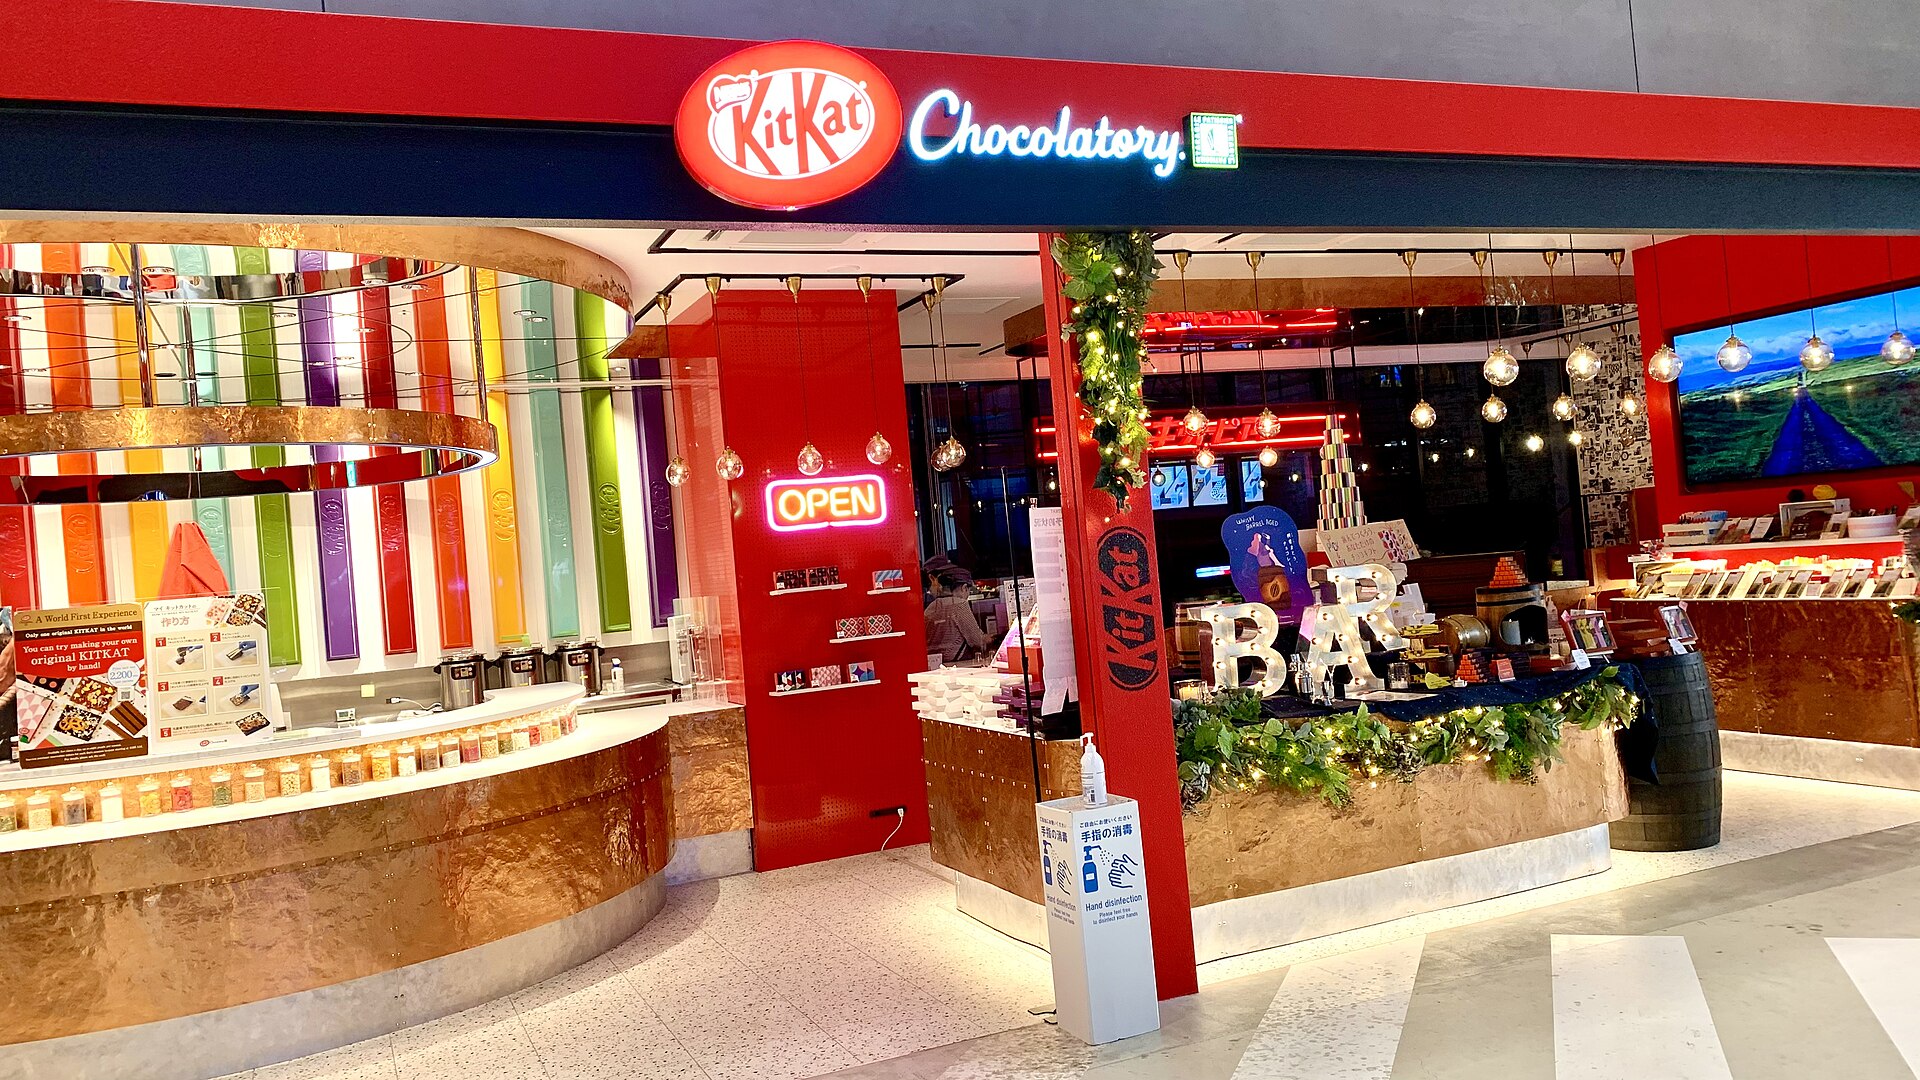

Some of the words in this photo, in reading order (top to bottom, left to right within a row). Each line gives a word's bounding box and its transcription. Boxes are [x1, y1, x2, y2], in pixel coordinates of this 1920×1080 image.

[732, 72, 864, 175] KitKat
[909, 88, 1187, 177] Chocolatory.
[778, 484, 876, 521] OPEN
[45, 614, 69, 623] World
[71, 612, 91, 621] First
[92, 609, 138, 620] Experience
[1100, 546, 1157, 672] KitKat
[160, 615, 190, 628] 作り方
[51, 629, 73, 637] original
[1187, 564, 1411, 702] BAR
[23, 646, 38, 654] You
[56, 643, 69, 651] try
[70, 640, 100, 650] making
[101, 640, 120, 648] your
[31, 652, 76, 666] original
[79, 647, 131, 661] KITKAT
[67, 664, 77, 673] by
[79, 662, 101, 671] hand!
[1081, 823, 1133, 843] 手指の消毒
[1085, 901, 1103, 912] Hand
[1104, 894, 1143, 908] disinfection
